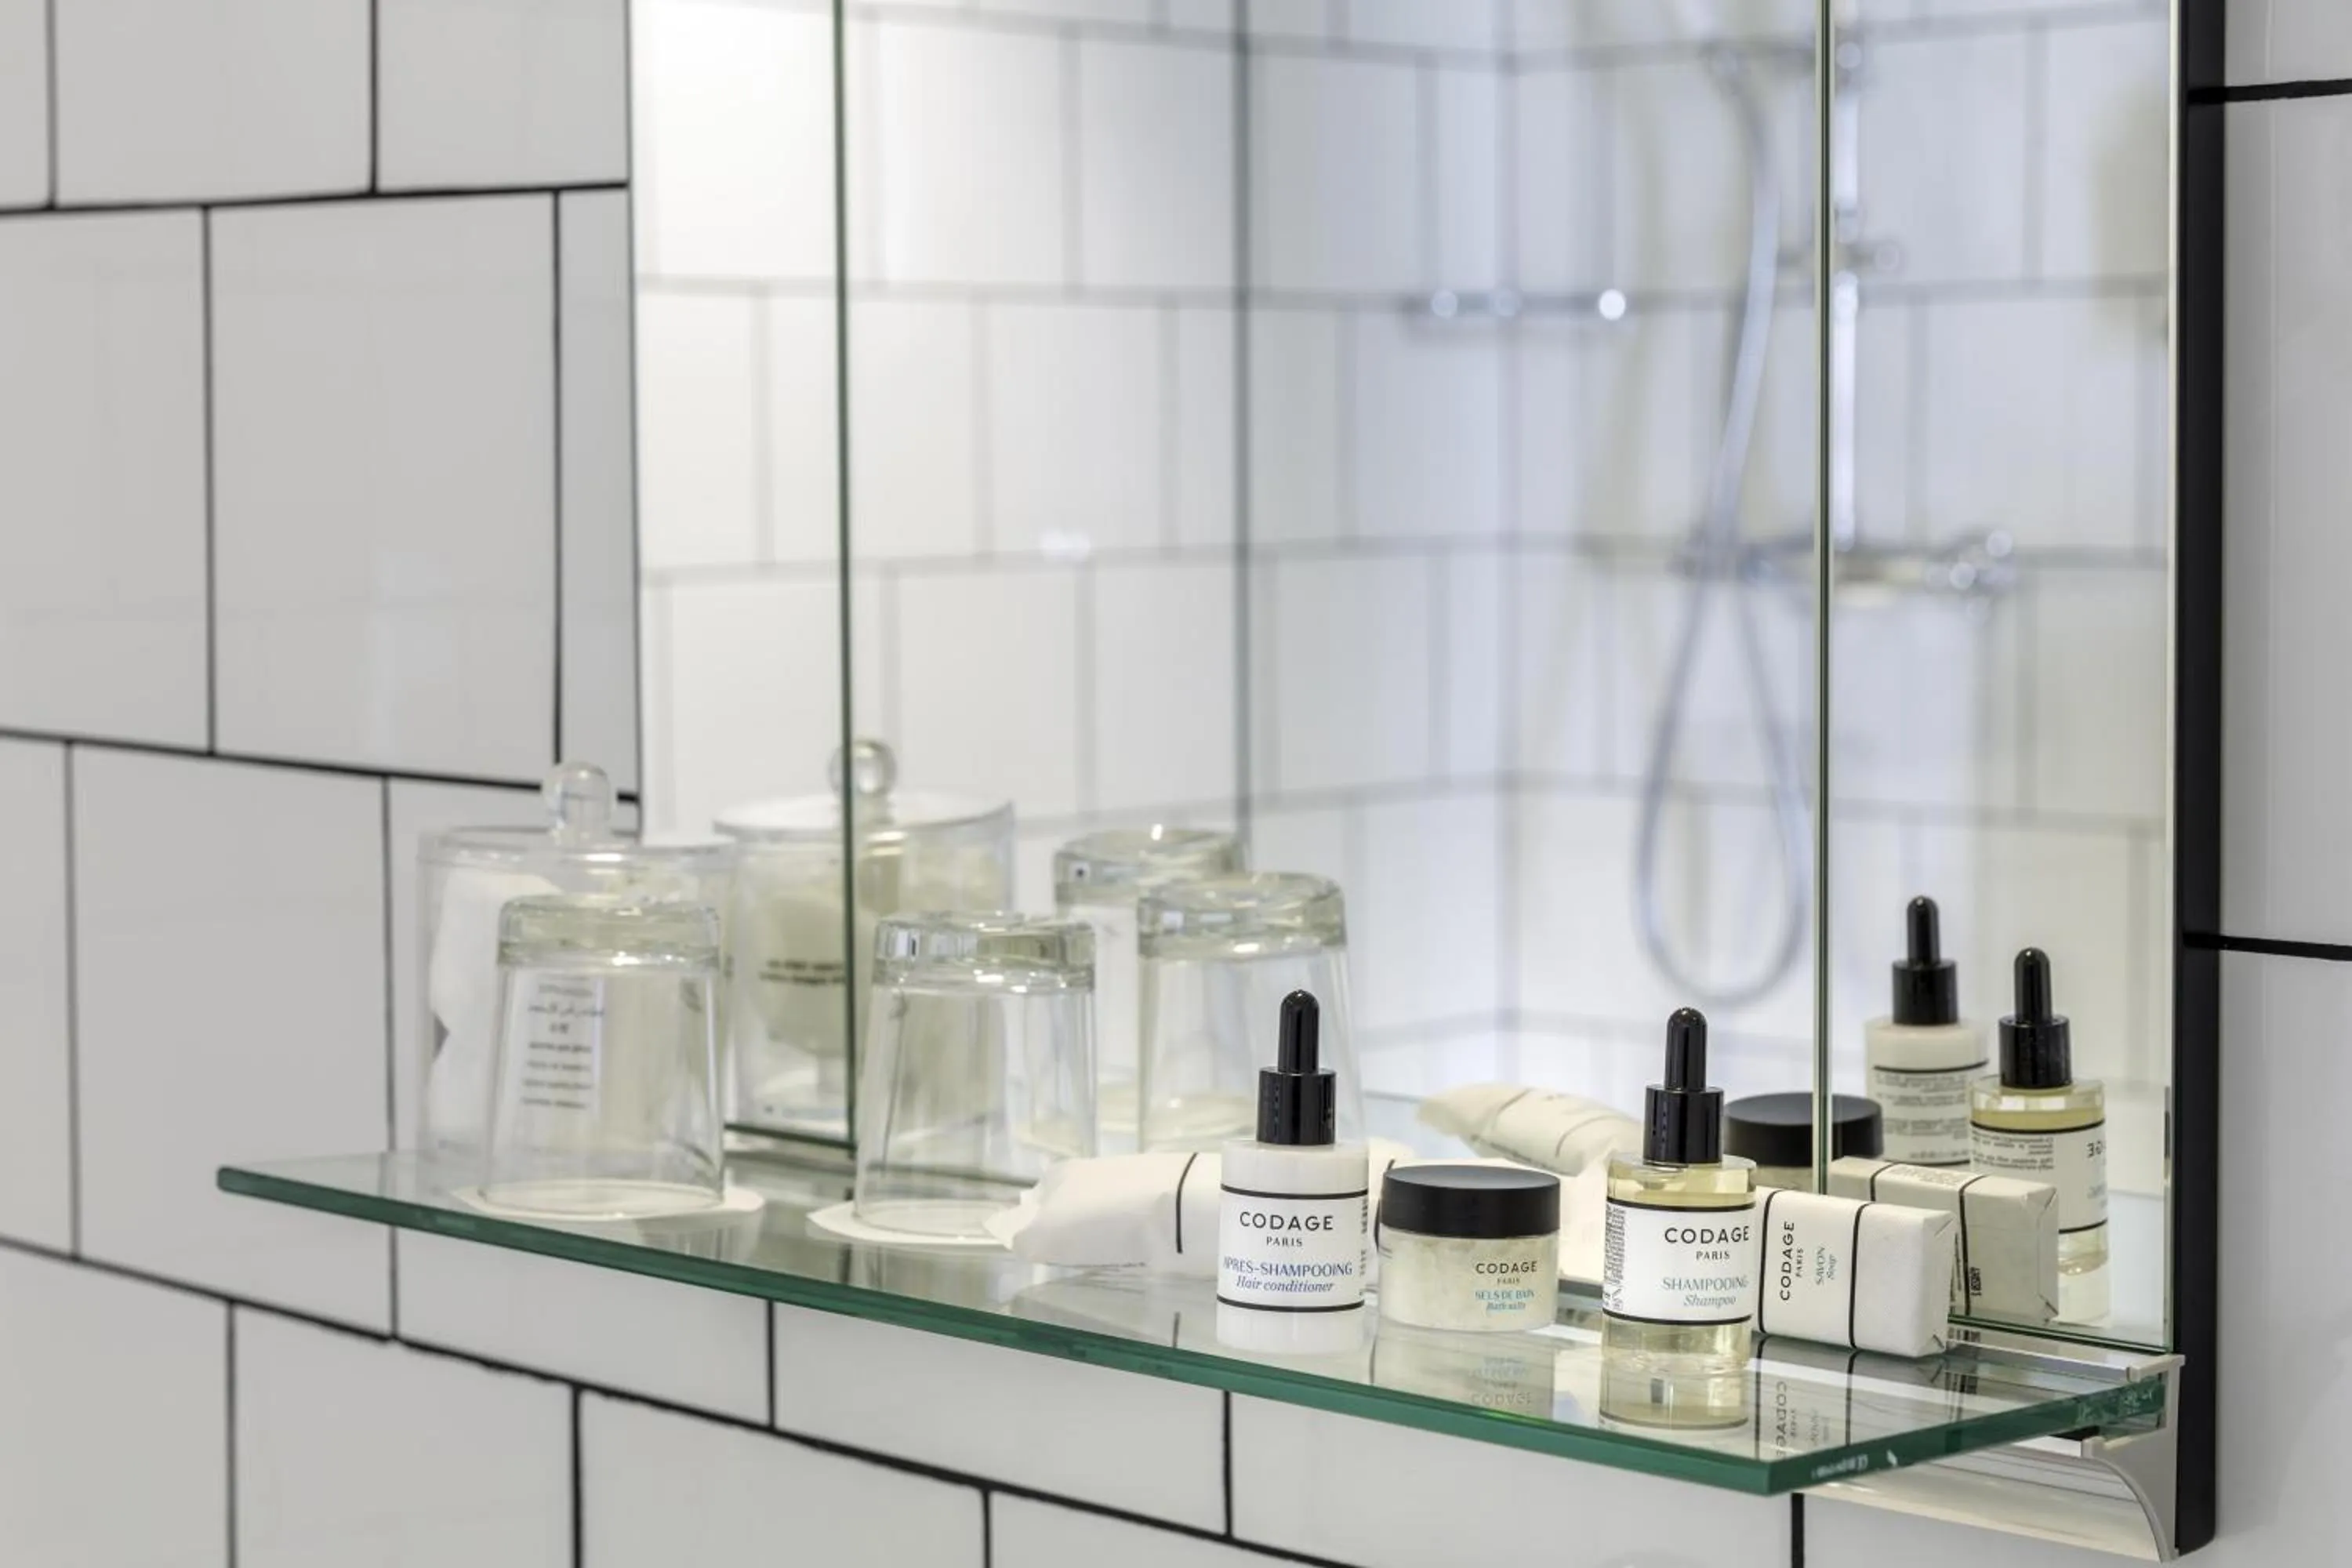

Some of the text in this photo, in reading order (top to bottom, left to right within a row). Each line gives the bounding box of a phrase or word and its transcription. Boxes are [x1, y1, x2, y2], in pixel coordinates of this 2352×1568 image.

[1240, 1211, 1334, 1231] CODAGE
[1266, 1236, 1303, 1247] PARIS
[1664, 1225, 1750, 1245] CODAGE
[1696, 1250, 1731, 1261] PARIS
[1779, 1221, 1795, 1301] CODAGE
[1795, 1247, 1804, 1279] PARIS
[1475, 1260, 1537, 1274] CODAGE
[1236, 1275, 1336, 1293] Hair conditioner
[1683, 1294, 1737, 1309] Shampoo
